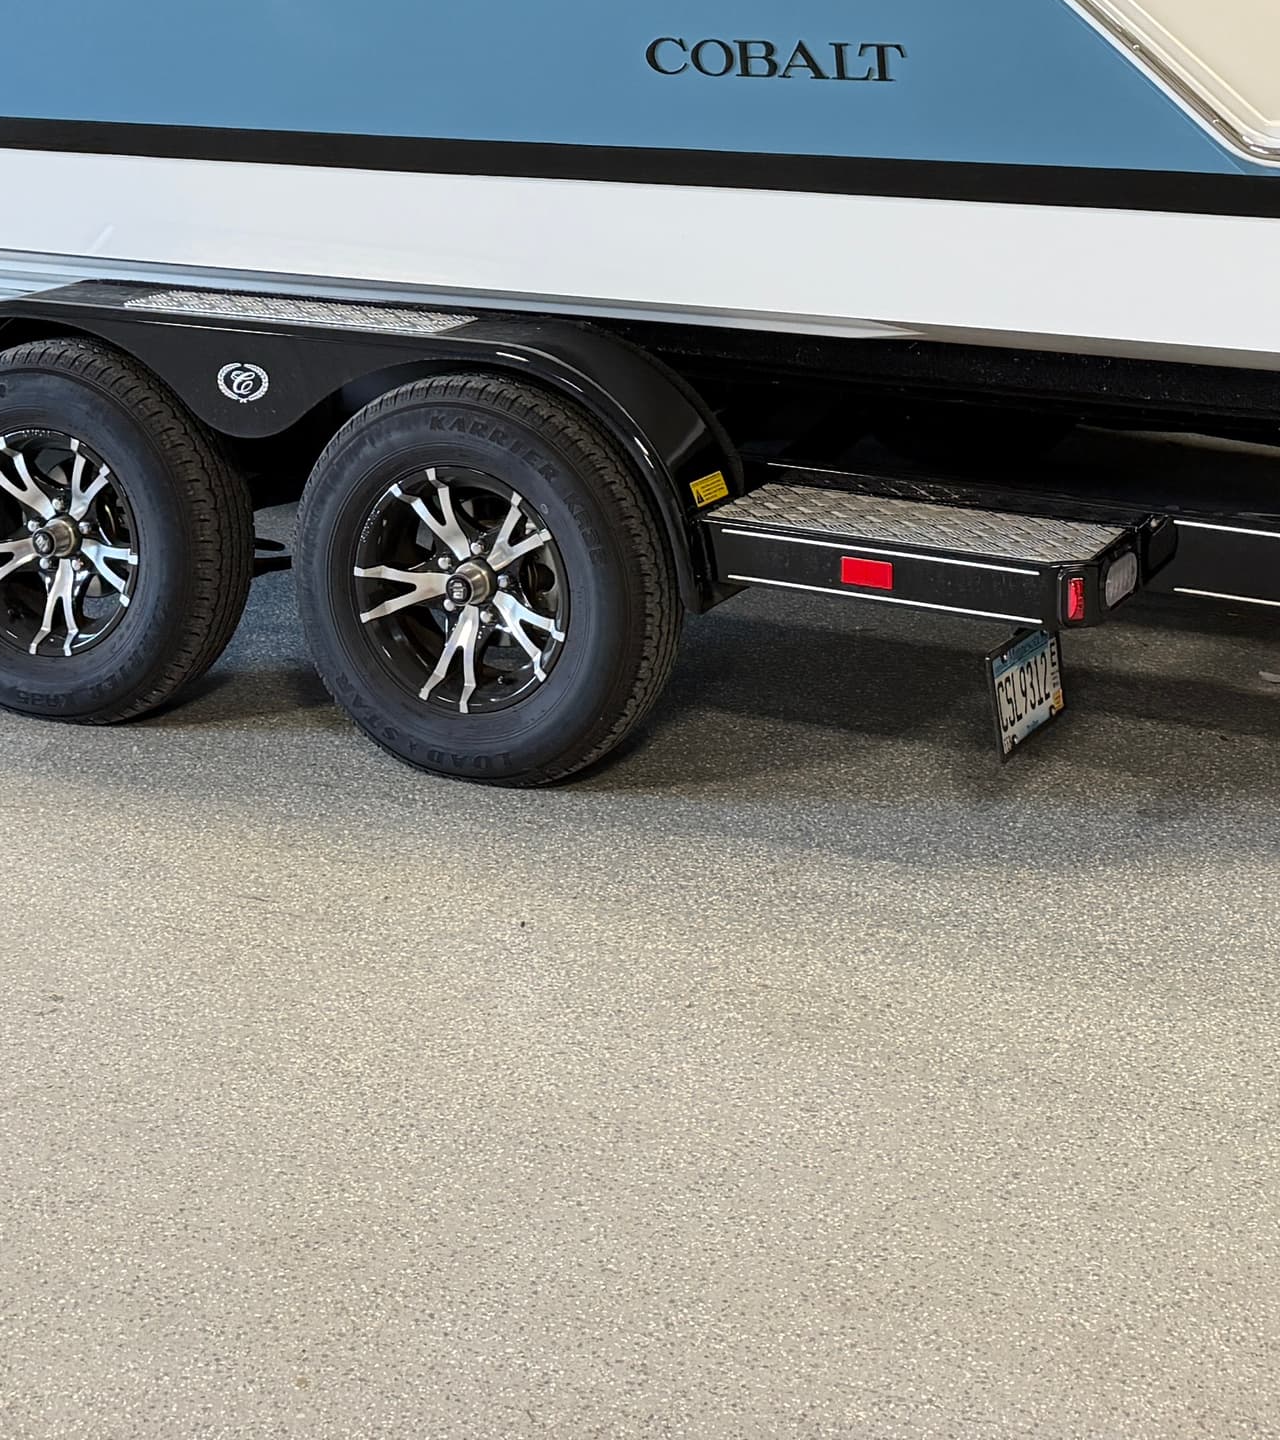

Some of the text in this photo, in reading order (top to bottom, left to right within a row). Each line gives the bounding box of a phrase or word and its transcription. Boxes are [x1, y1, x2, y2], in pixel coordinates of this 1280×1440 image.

[645, 36, 908, 82] COBALT
[428, 414, 561, 484] KARRIER
[997, 651, 1051, 733] CSL9312
